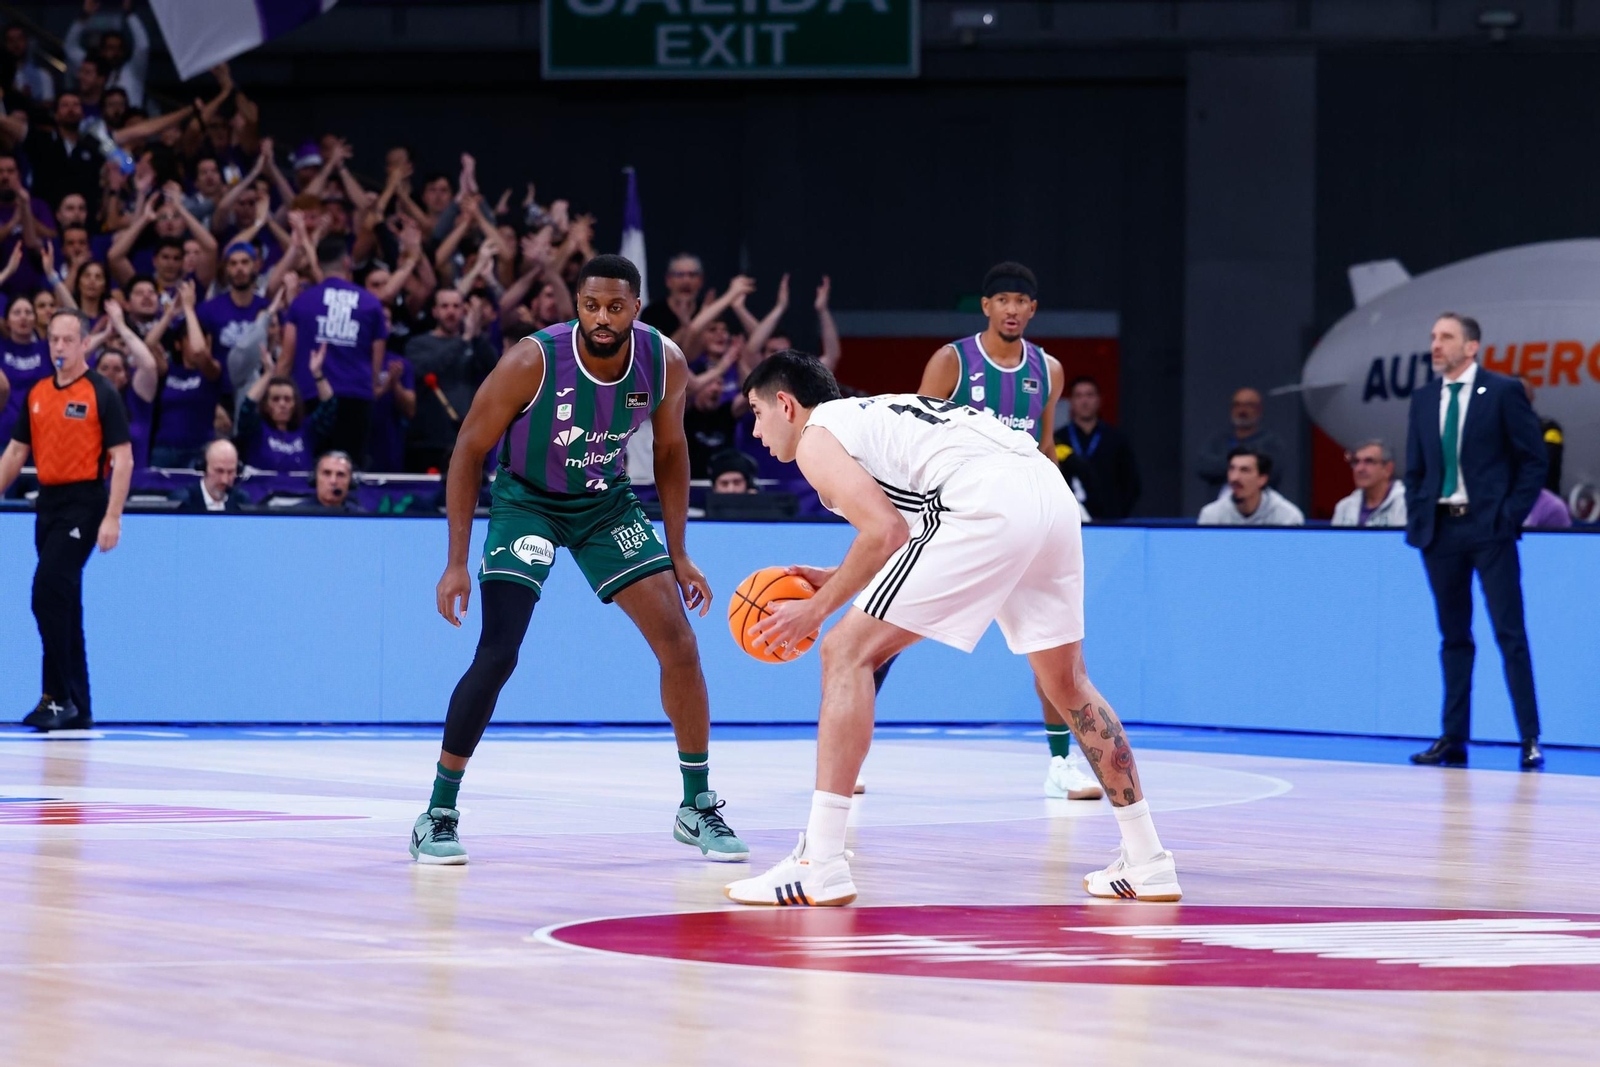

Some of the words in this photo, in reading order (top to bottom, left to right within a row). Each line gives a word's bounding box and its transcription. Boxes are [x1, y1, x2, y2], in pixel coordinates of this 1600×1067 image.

[656, 23, 797, 66] EXIT
[316, 315, 360, 341] TOUR
[565, 448, 621, 469] málaga
[617, 532, 650, 552] laga
